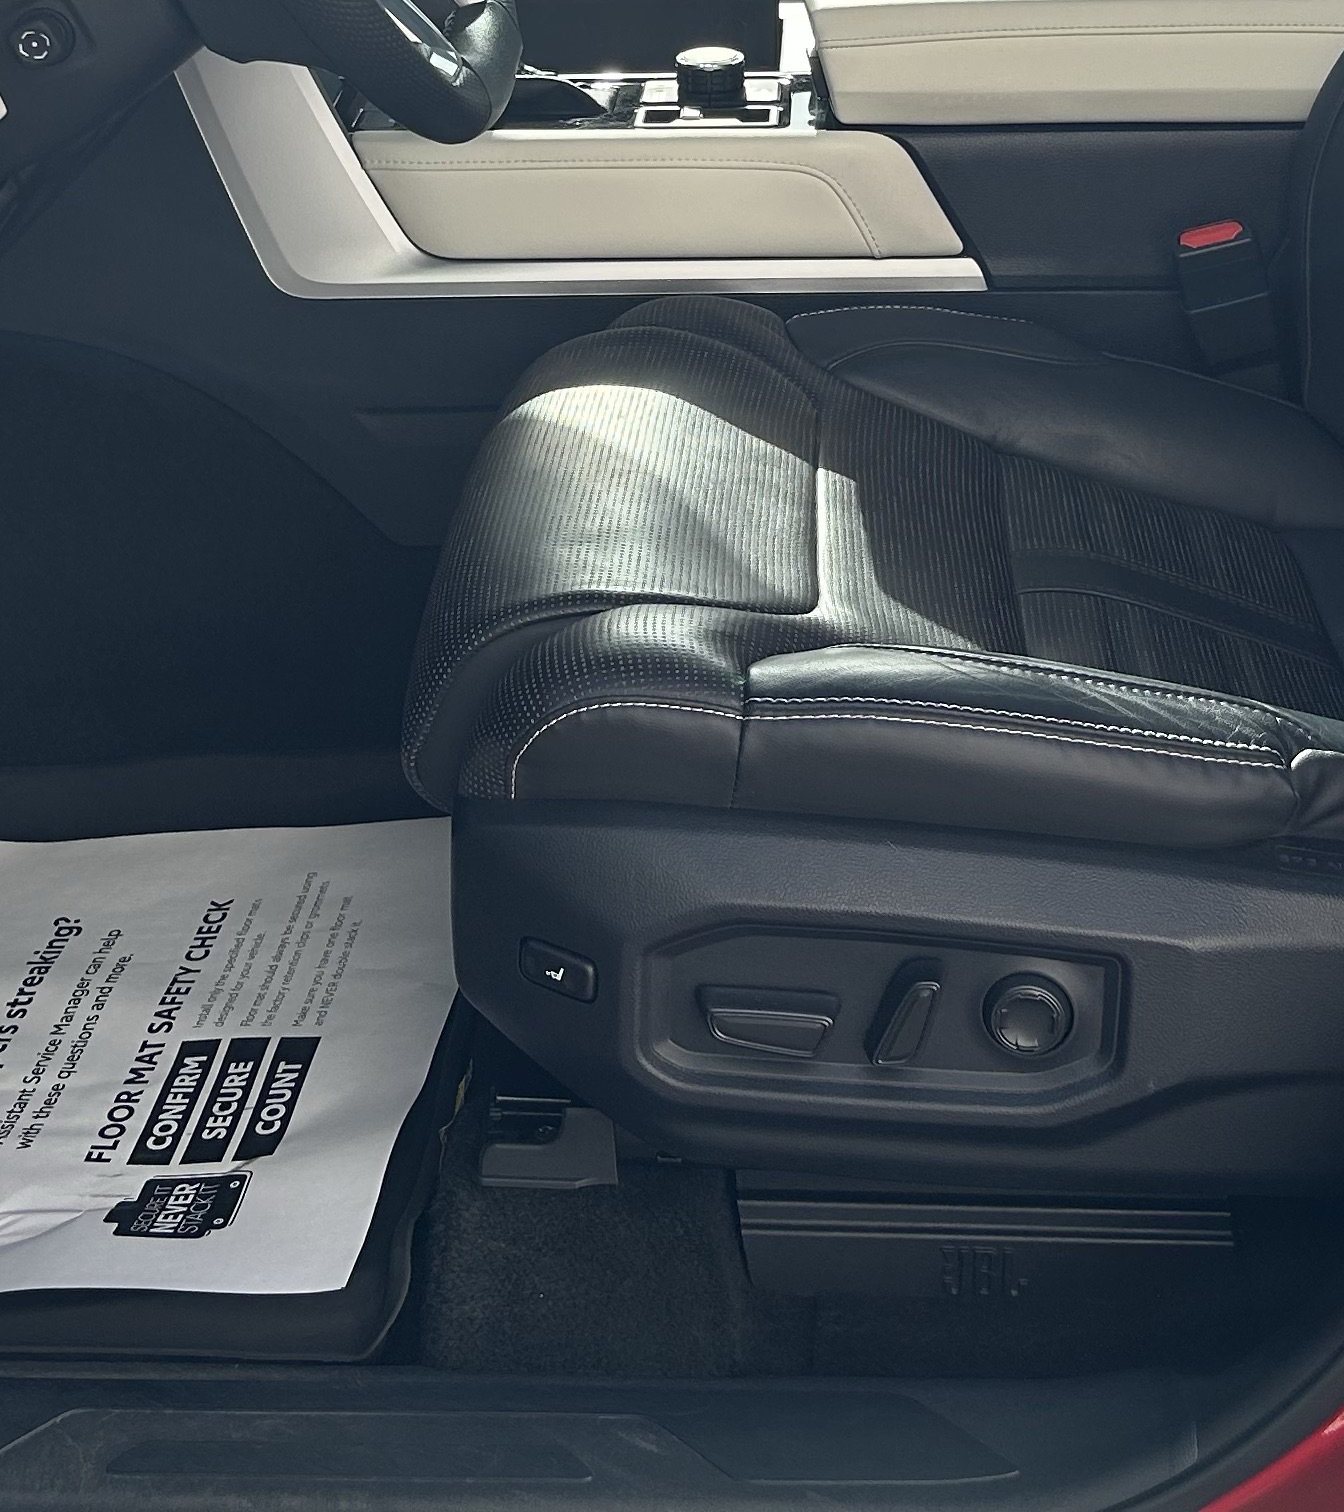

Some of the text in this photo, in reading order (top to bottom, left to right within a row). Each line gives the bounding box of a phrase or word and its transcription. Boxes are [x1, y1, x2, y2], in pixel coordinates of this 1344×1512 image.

[6, 917, 82, 1018] streaking?
[23, 1033, 62, 1084] Service
[52, 977, 98, 1035] Manager
[86, 952, 105, 974] can
[97, 930, 122, 953] help
[16, 954, 133, 1149] with these questions and more.
[84, 899, 234, 1162] FLOOR MAT SAFETY CHECK
[147, 1056, 207, 1150] CONFIRM
[202, 1062, 253, 1139] SECURE
[255, 1062, 302, 1134] COUNT
[132, 1197, 167, 1231] SECURE
[150, 1183, 200, 1232] NEVER
[178, 1195, 215, 1233] STACK
